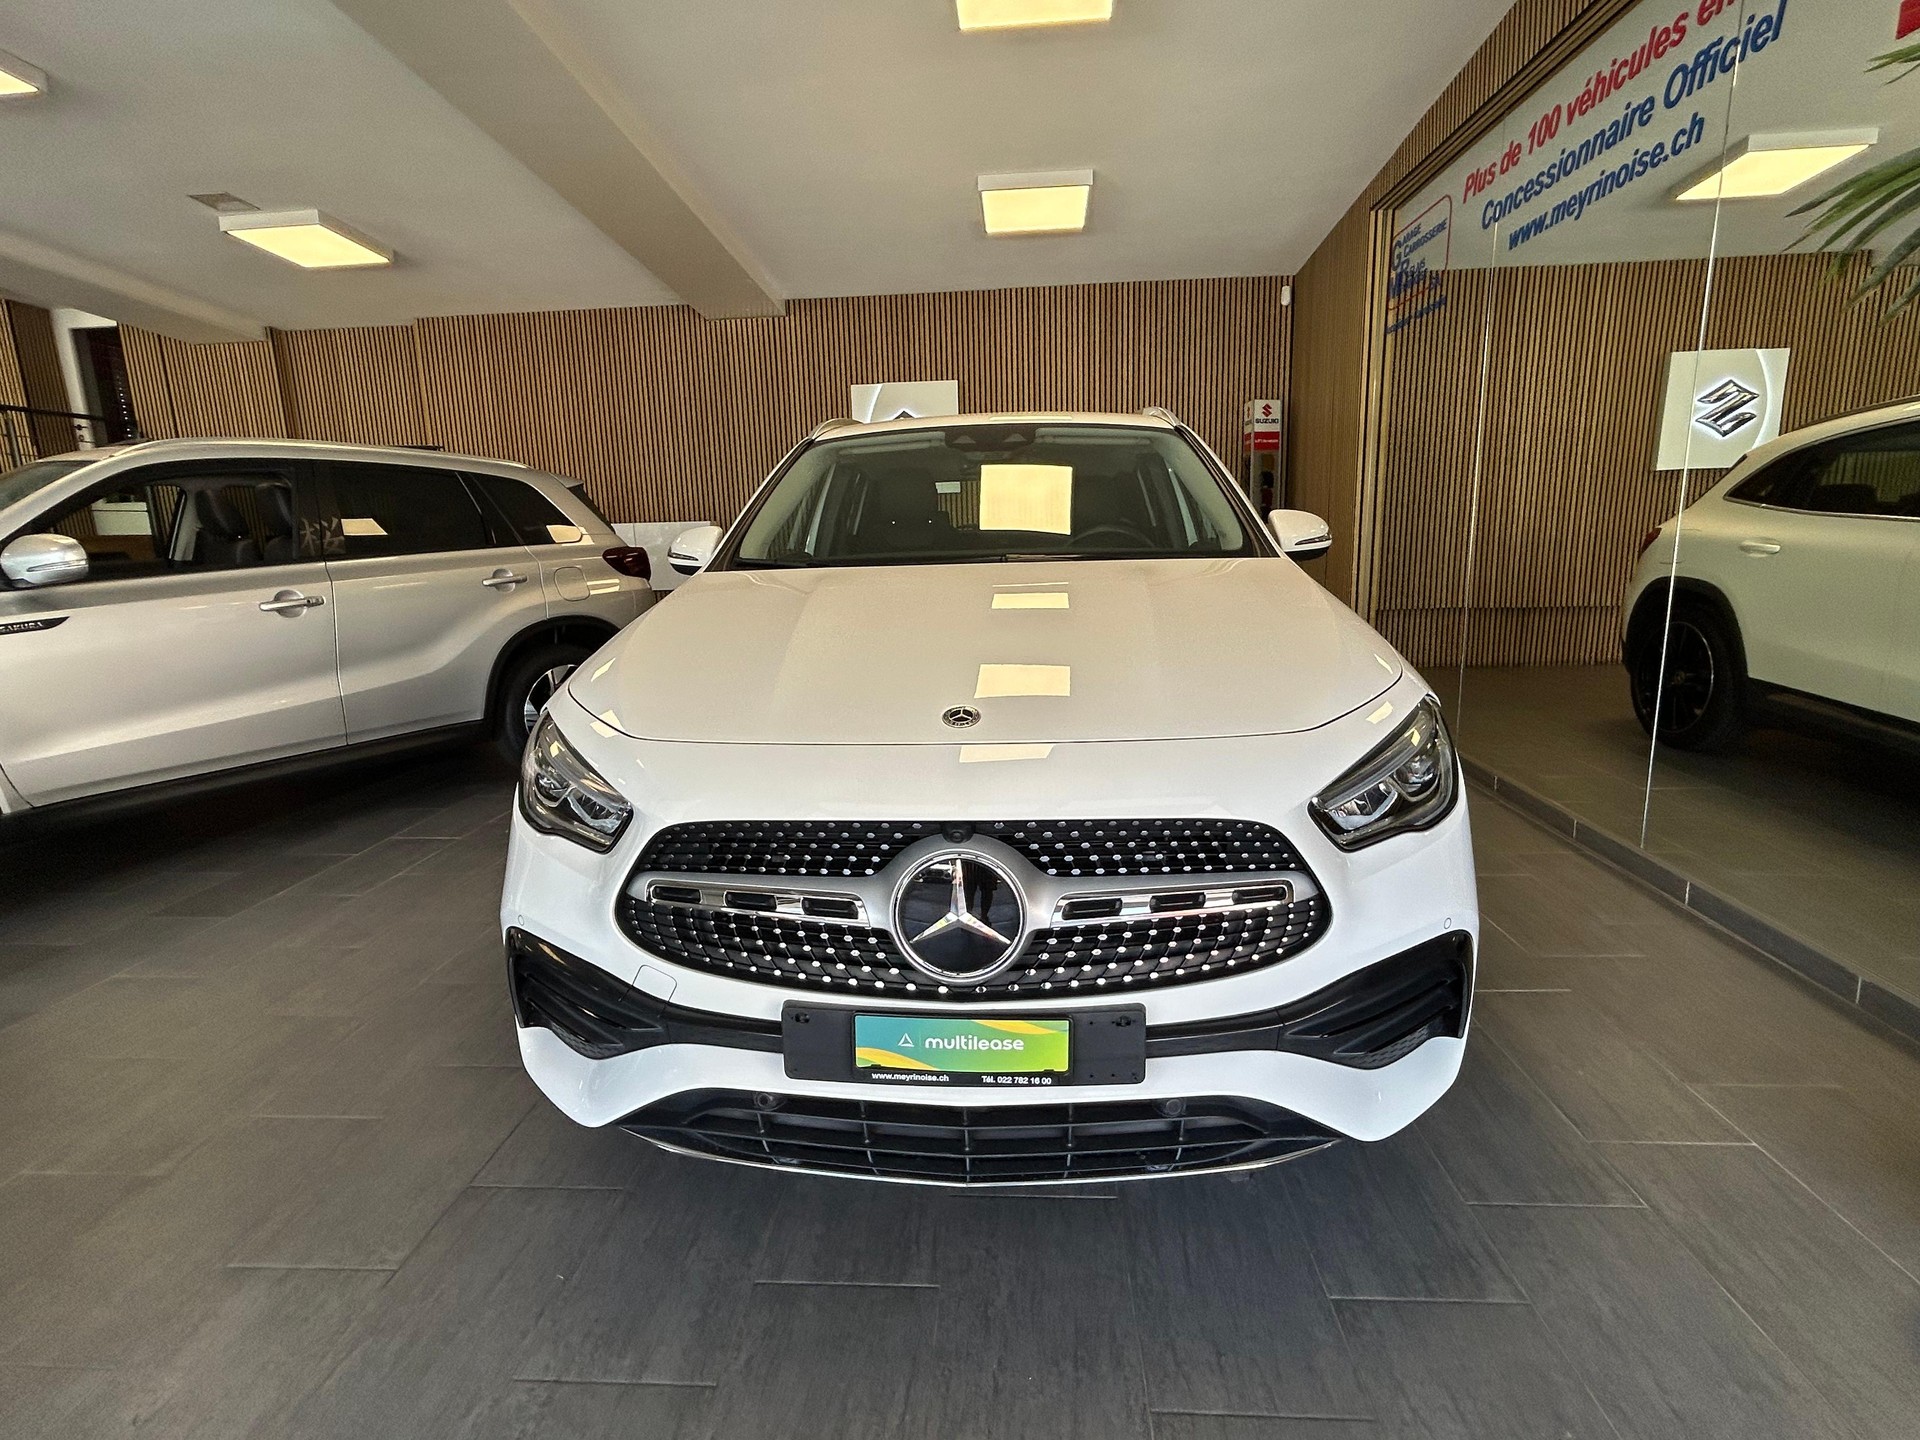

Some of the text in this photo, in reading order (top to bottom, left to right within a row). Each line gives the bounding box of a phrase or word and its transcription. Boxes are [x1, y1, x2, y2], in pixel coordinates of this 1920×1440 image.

[1463, 0, 1735, 204] Plus de 100 véhicules e
[1482, 0, 1787, 230] Concessionnaire Officiel
[1509, 112, 1705, 250] www.meyrinoise.ch
[871, 1072, 950, 1082] www.meyrinoise.ch
[924, 1034, 1025, 1051] multilease
[997, 1076, 1013, 1084] 022
[1013, 1076, 1029, 1085] 782
[1030, 1077, 1041, 1085] 16
[1041, 1077, 1052, 1085] 00
